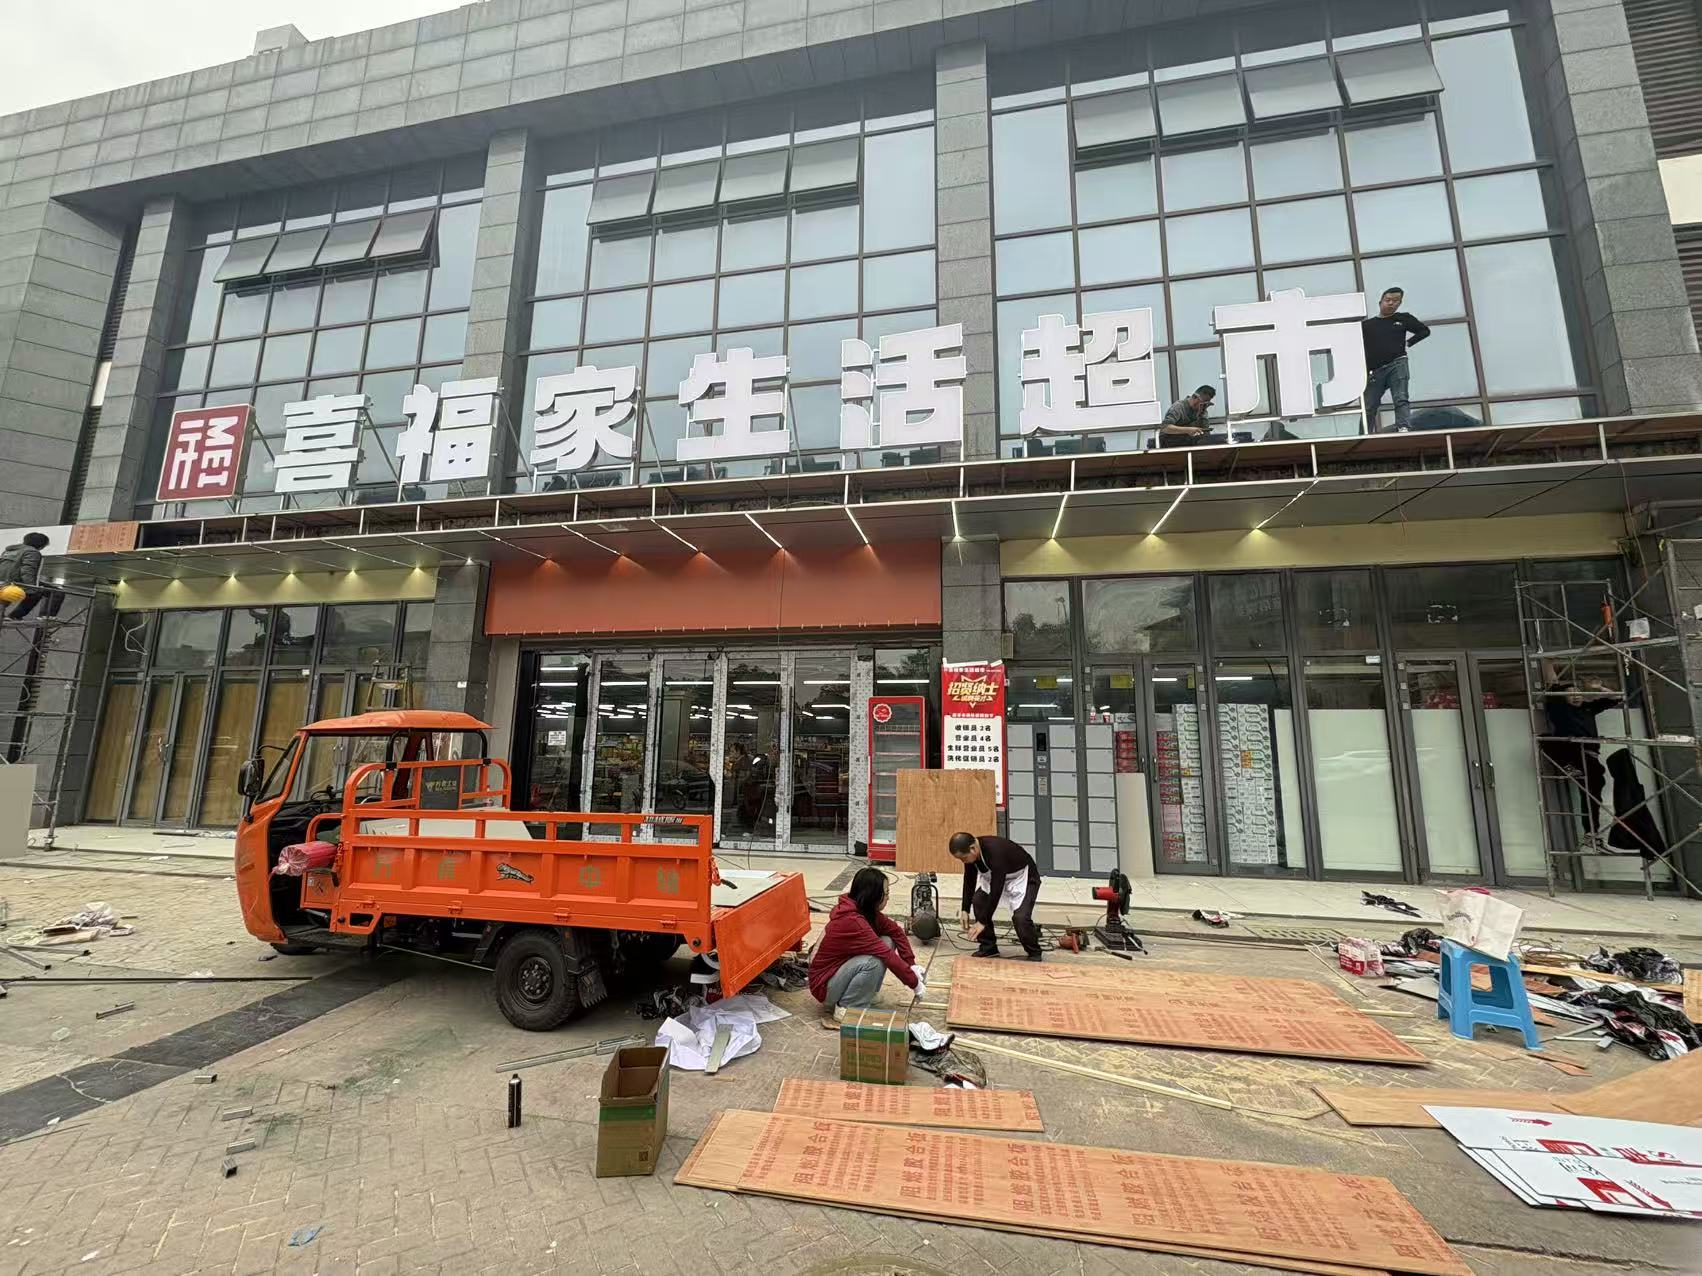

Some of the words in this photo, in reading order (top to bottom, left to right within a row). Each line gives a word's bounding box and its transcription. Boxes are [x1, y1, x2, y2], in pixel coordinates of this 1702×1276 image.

[272, 286, 1367, 495] 喜福家生活超市
[947, 681, 999, 696] 招贤纳士
[954, 724, 978, 732] 收银员
[980, 724, 992, 732] 2名
[954, 734, 978, 742] 营业员
[979, 734, 992, 742] 4名
[987, 755, 1000, 763] 2名
